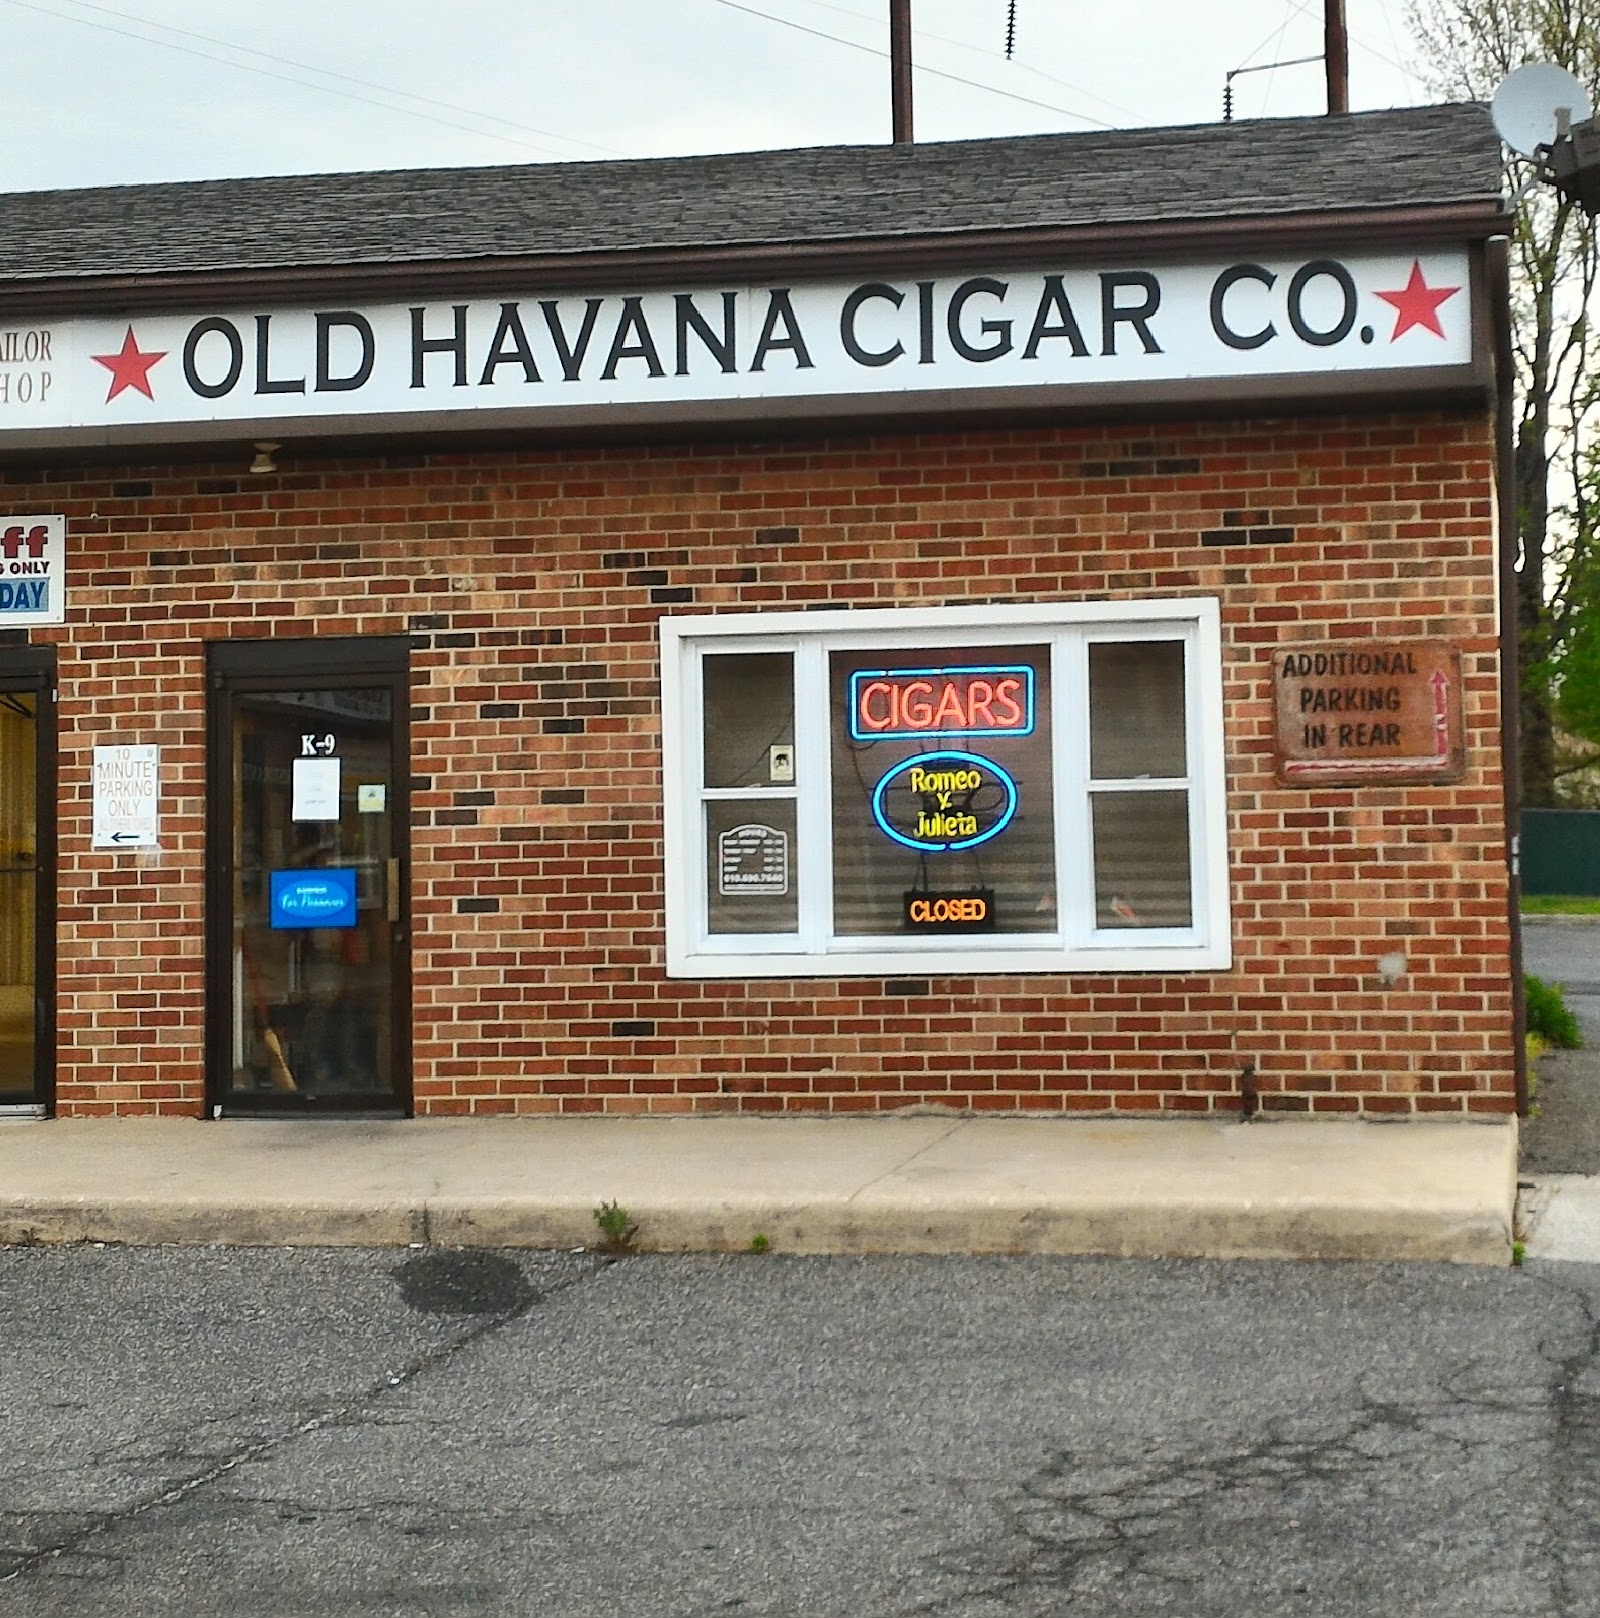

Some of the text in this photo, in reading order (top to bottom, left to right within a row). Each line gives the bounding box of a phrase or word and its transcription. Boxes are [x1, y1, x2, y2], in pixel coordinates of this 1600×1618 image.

[183, 259, 1374, 399] OLD HAVANA CIGAR CO.
[10, 561, 50, 575] ONLY
[1281, 651, 1417, 679] ADDITIONAL
[860, 678, 1023, 730] CIGARS
[1300, 687, 1402, 713] PARKING
[300, 733, 336, 756] K-9
[1303, 722, 1402, 749] IN REAR
[116, 748, 131, 760] 10
[99, 761, 151, 779] MINUTE
[909, 767, 981, 793] Romeo
[99, 780, 153, 797] PARKING
[108, 799, 141, 817] ONLY
[913, 811, 978, 838] Julieta
[909, 898, 987, 923] CLOSED
